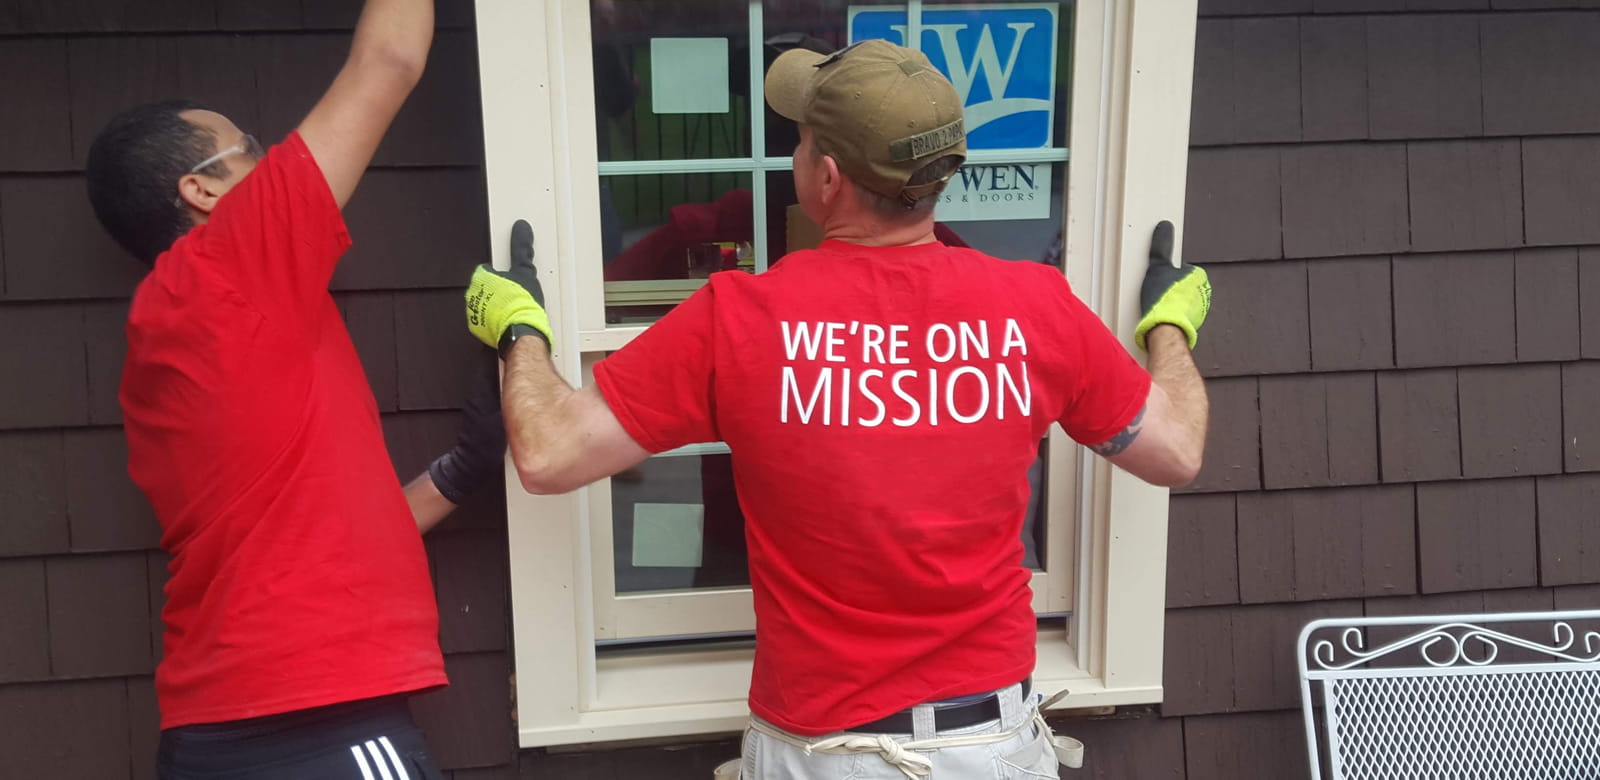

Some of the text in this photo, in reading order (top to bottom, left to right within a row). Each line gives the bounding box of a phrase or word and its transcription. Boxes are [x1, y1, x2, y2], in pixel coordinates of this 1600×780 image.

[913, 132, 940, 155] BRAVO
[941, 129, 948, 146] 2
[961, 194, 969, 203] &
[980, 192, 1034, 203] DOORS
[780, 318, 1028, 364] WE'RE ON A
[780, 361, 1032, 428] MISSION
